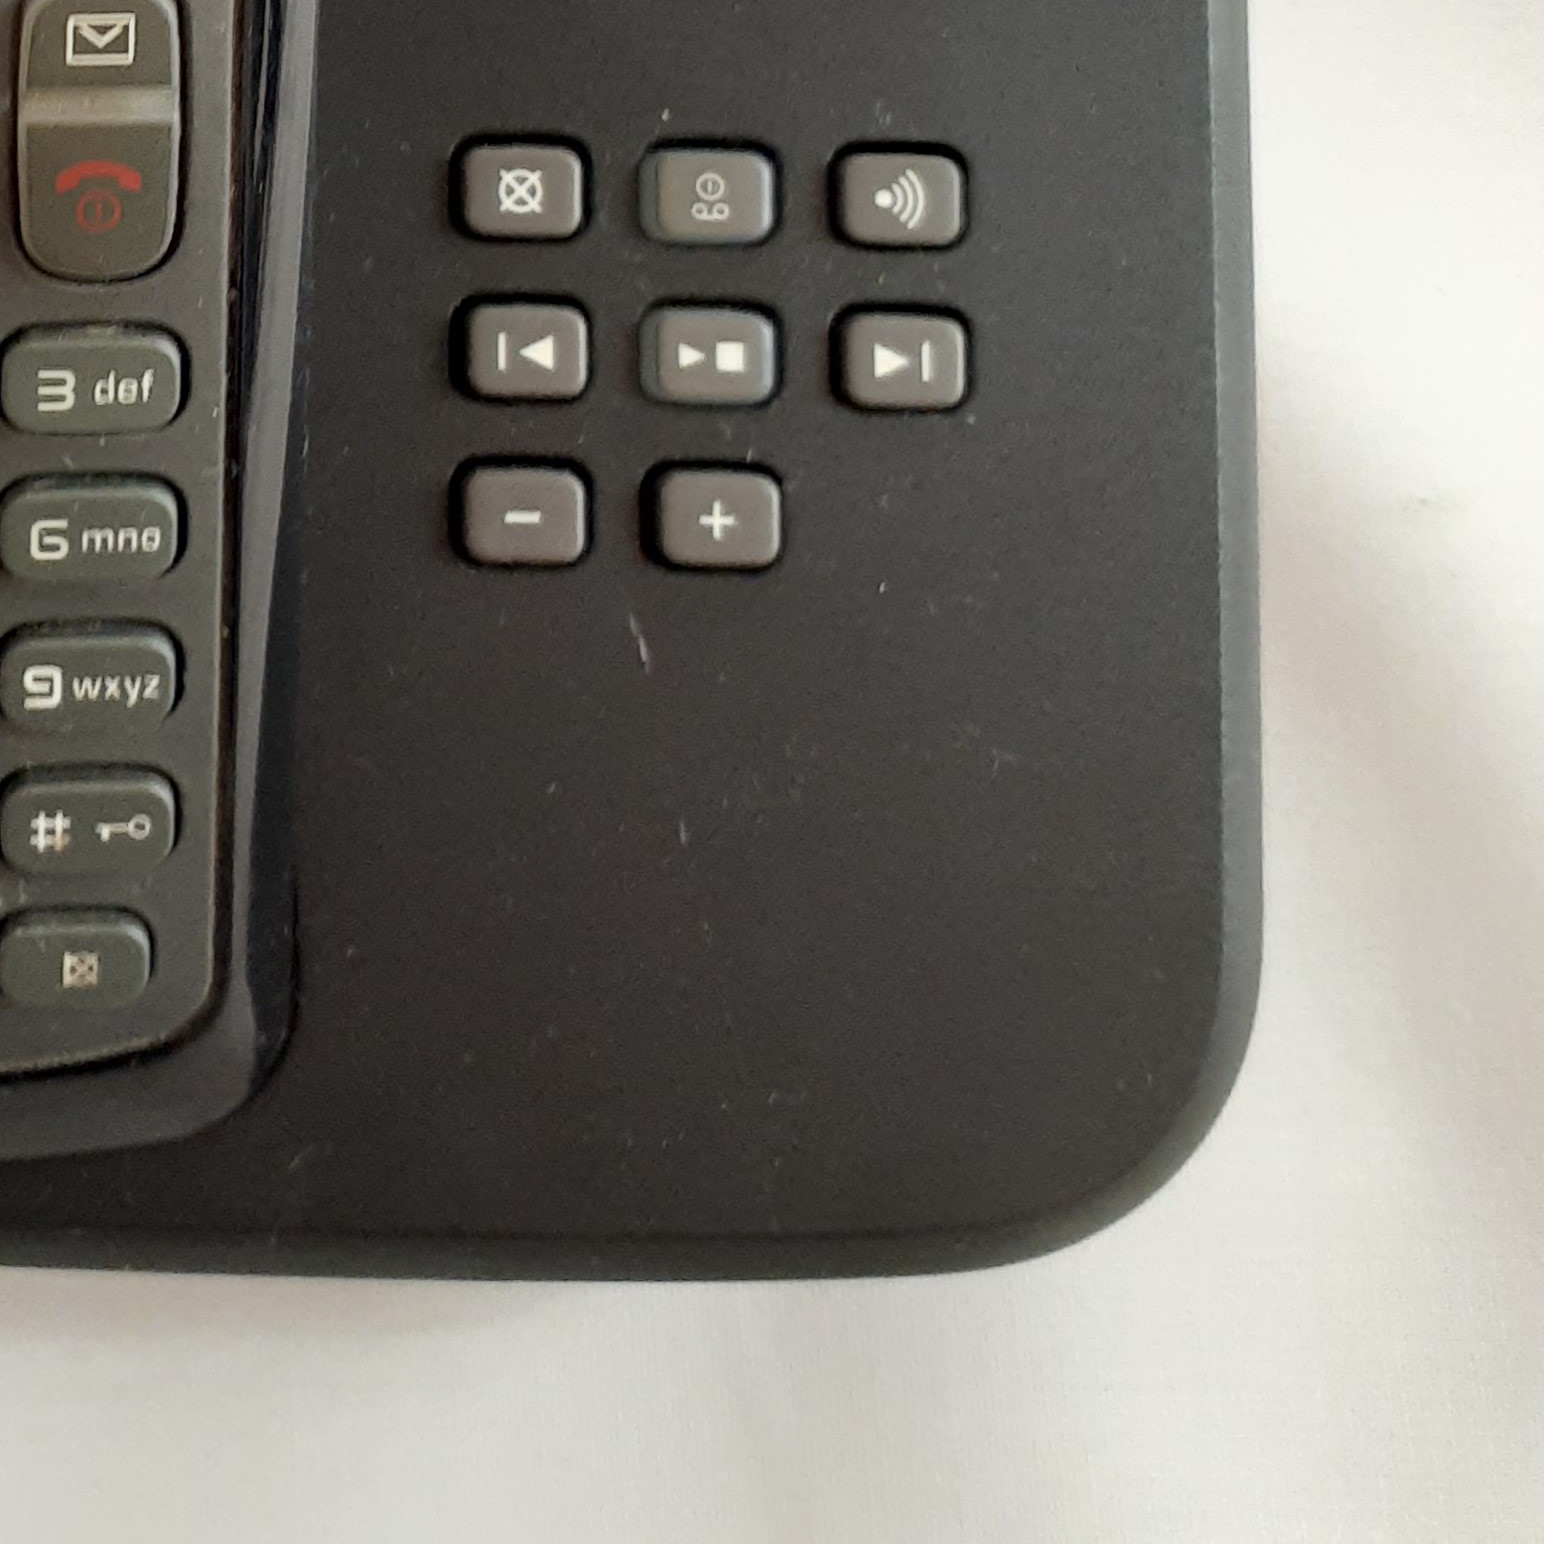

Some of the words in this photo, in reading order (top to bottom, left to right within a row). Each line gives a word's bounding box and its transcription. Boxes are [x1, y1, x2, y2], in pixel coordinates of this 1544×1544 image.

[36, 368, 77, 412] 3
[93, 368, 156, 407] def
[29, 517, 69, 561] 6
[81, 524, 161, 553] mno
[22, 664, 63, 711] 9
[71, 670, 161, 706] wxyz
